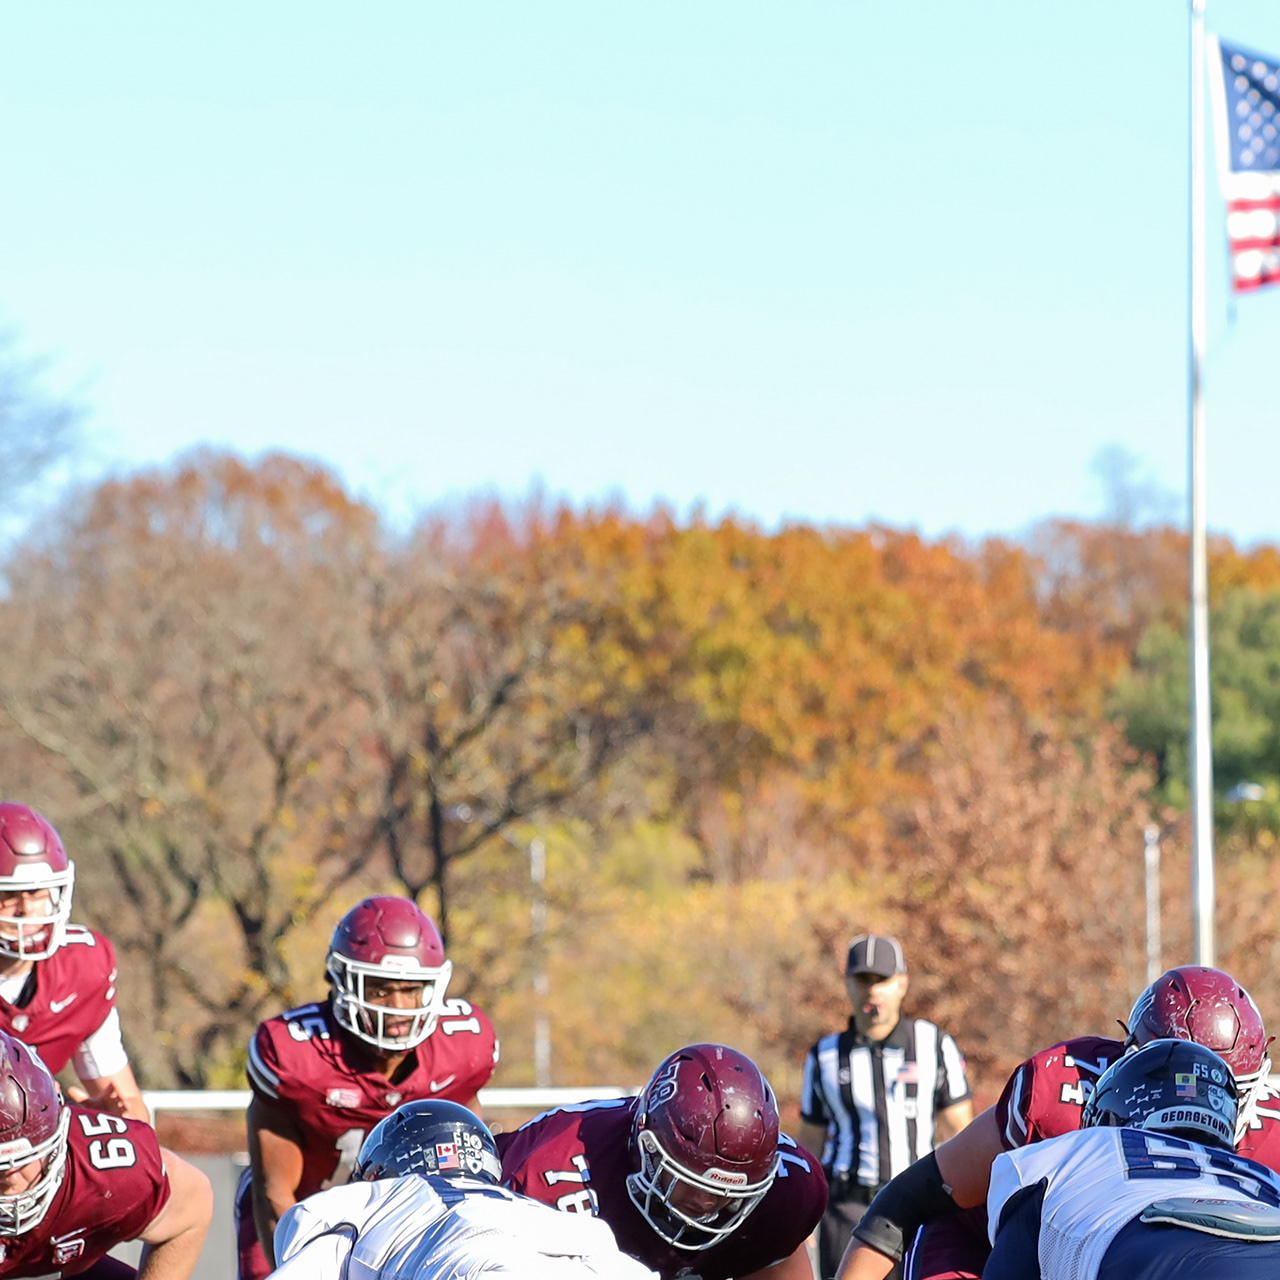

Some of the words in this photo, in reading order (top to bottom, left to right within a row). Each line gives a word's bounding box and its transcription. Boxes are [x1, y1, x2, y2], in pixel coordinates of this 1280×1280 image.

[1193, 1063, 1209, 1079] 65
[1160, 1110, 1231, 1139] GEORGETOWN
[78, 1112, 136, 1170] 65
[452, 1131, 471, 1147] 69
[710, 1172, 744, 1185] Riddell
